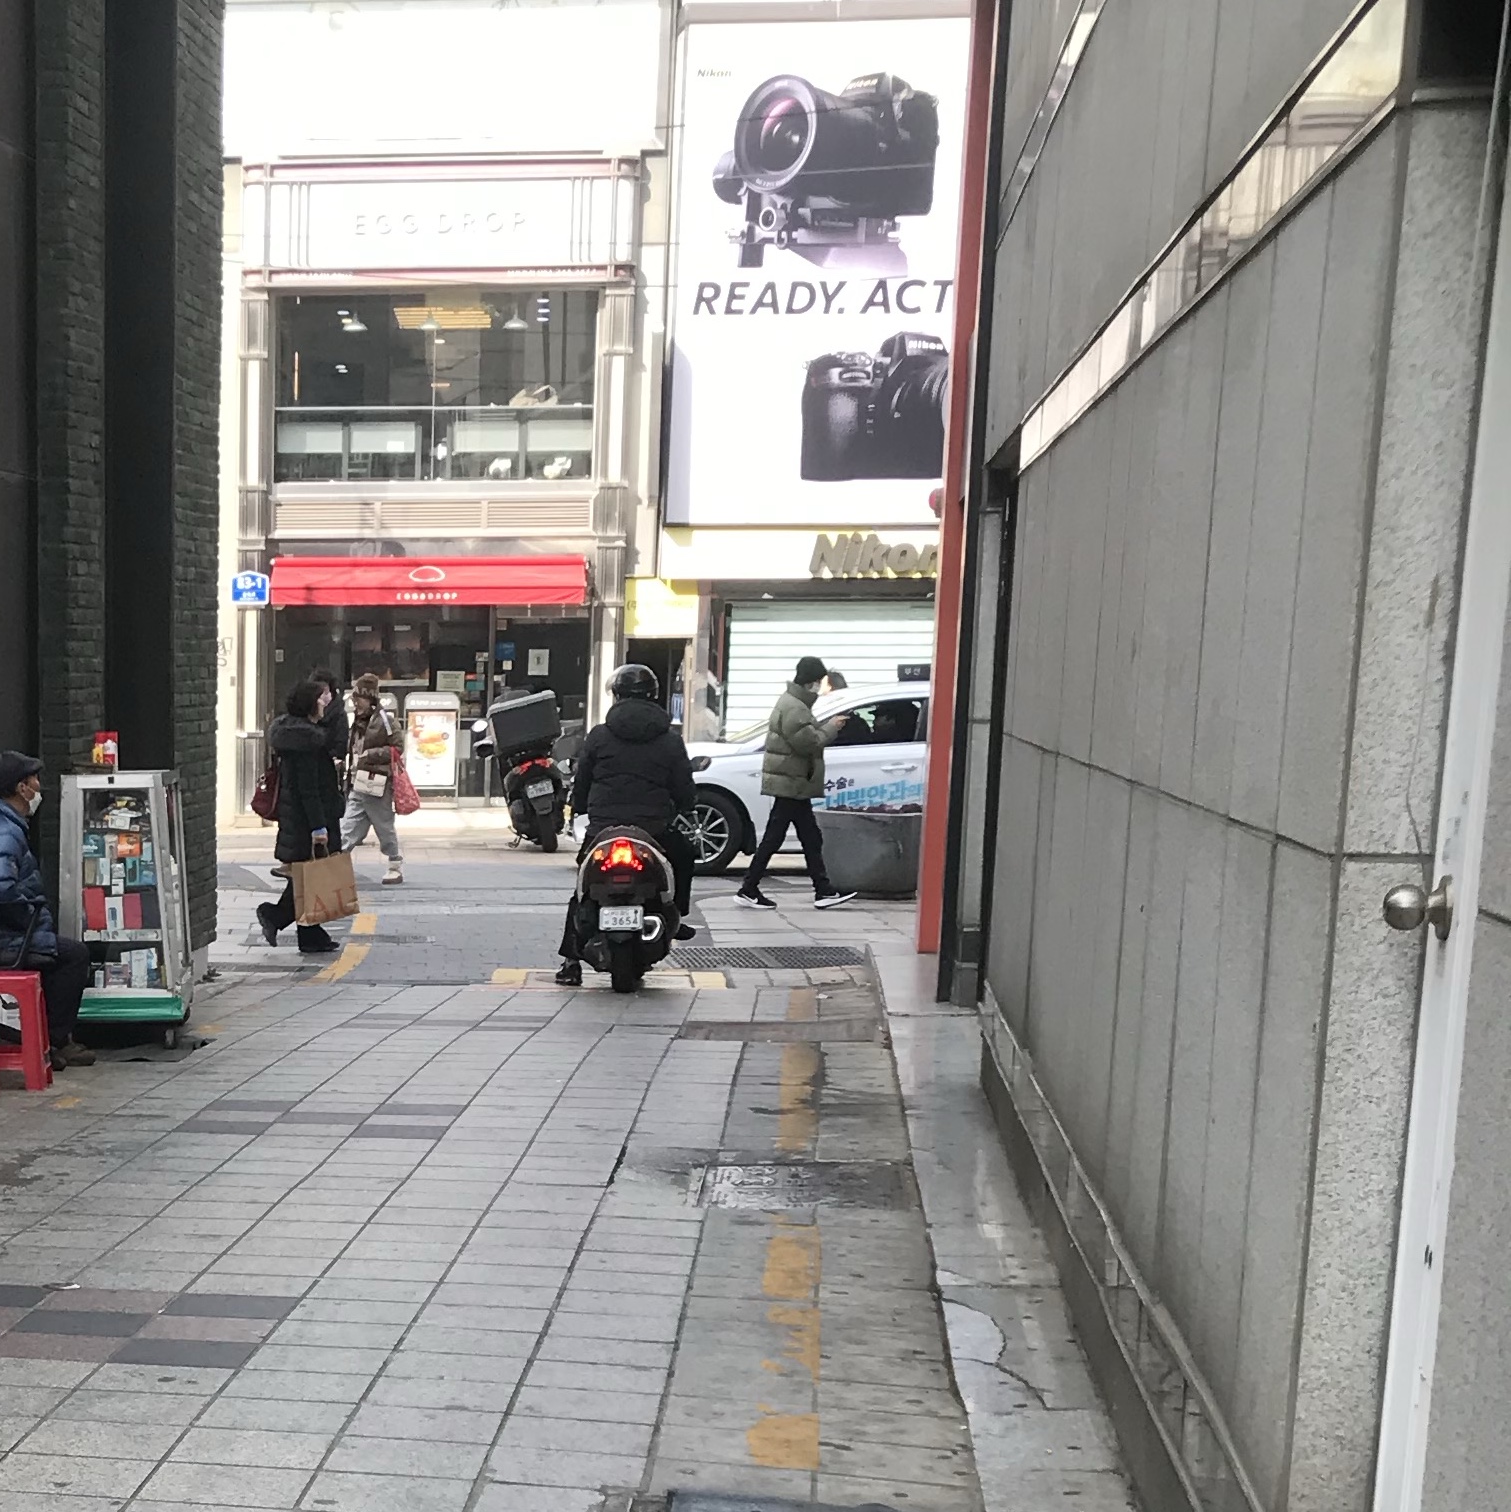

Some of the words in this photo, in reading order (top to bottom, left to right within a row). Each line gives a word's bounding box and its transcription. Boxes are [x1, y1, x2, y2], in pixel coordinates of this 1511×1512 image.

[354, 214, 419, 236] EGG
[437, 212, 526, 234] DROP
[692, 280, 847, 315] READY.
[611, 916, 638, 926] 3654
